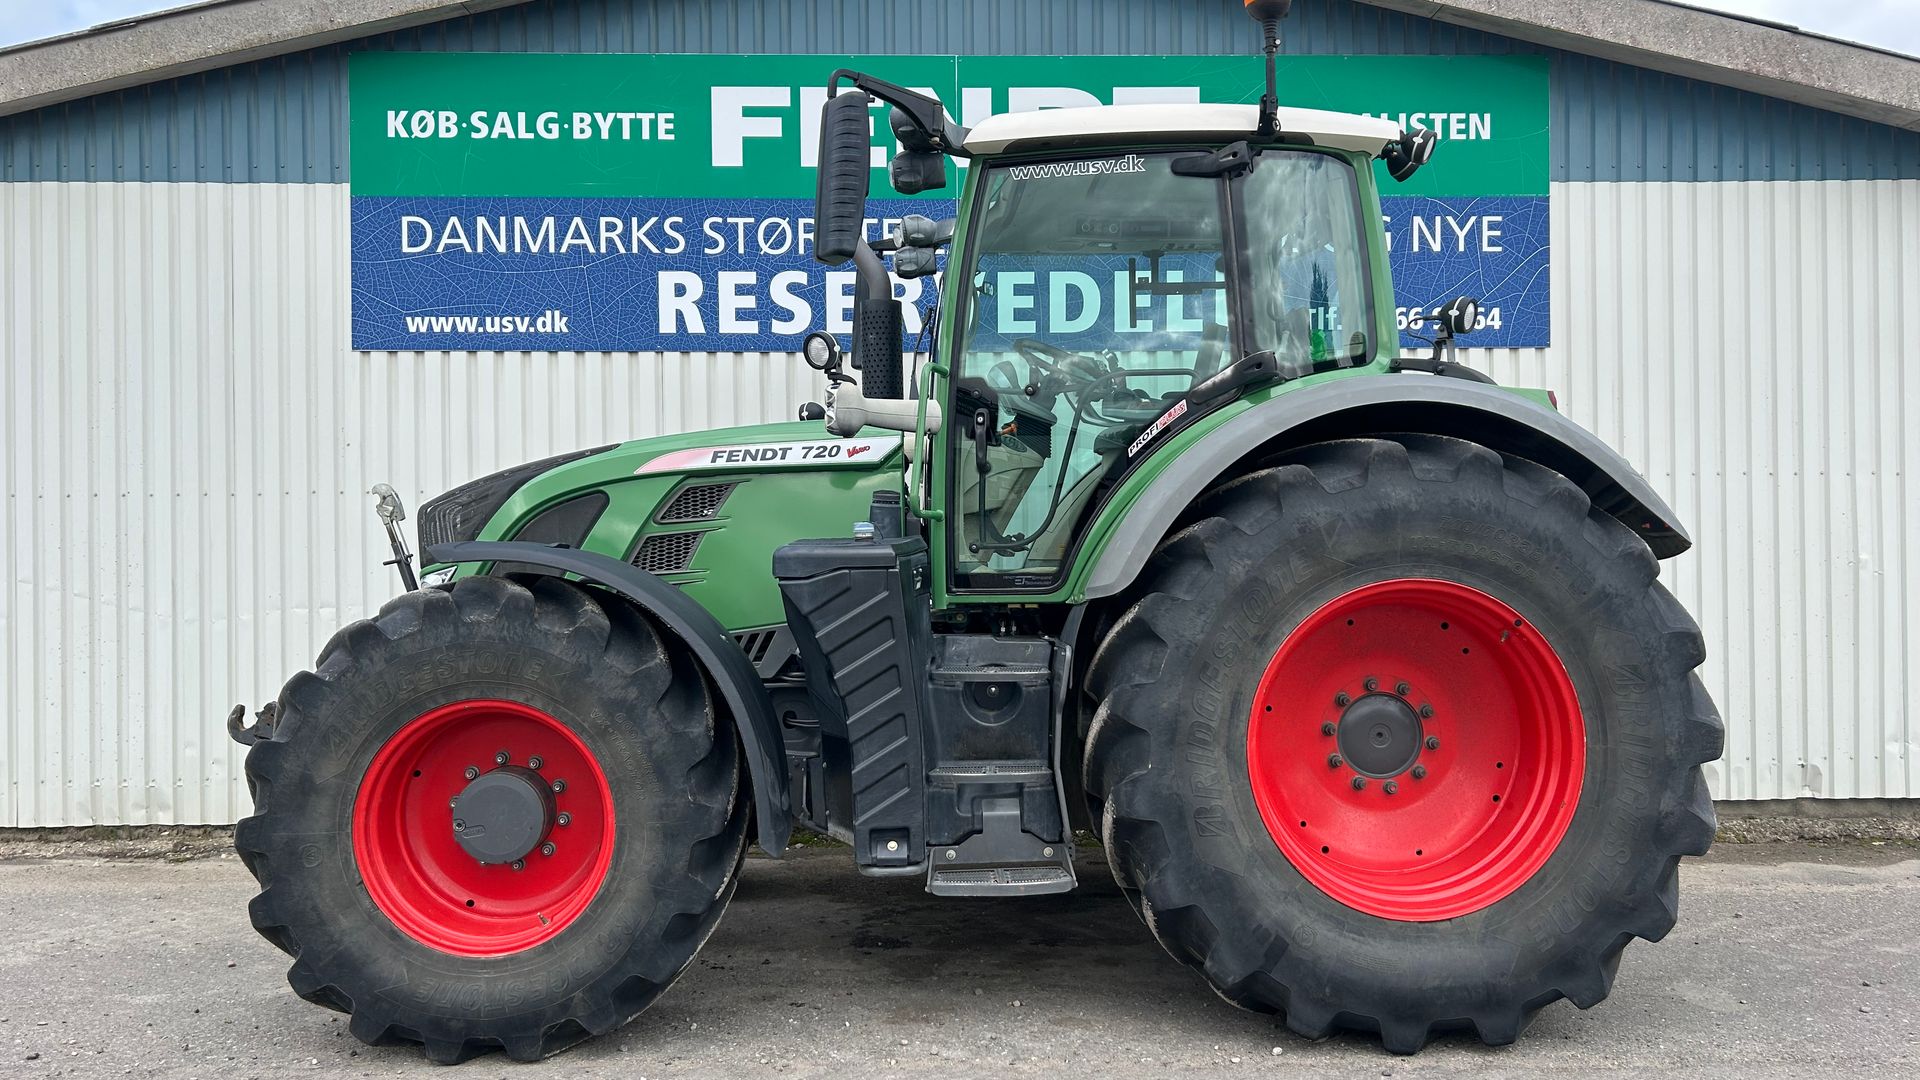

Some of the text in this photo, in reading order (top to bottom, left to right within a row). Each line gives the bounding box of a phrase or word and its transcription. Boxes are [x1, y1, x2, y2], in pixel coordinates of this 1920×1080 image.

[1009, 154, 1146, 180] www.usv.dk
[401, 216, 686, 254] DANMARKS
[1412, 215, 1502, 252] NYE
[406, 310, 569, 333] www.usv.dk
[1396, 307, 1424, 330] 66
[710, 447, 793, 463] FENDT
[801, 444, 841, 459] 720
[322, 648, 547, 757] BRIDGESTONE
[1185, 552, 1314, 840] BRIDGESTONE
[1526, 662, 1651, 953] BRIDGESTONE
